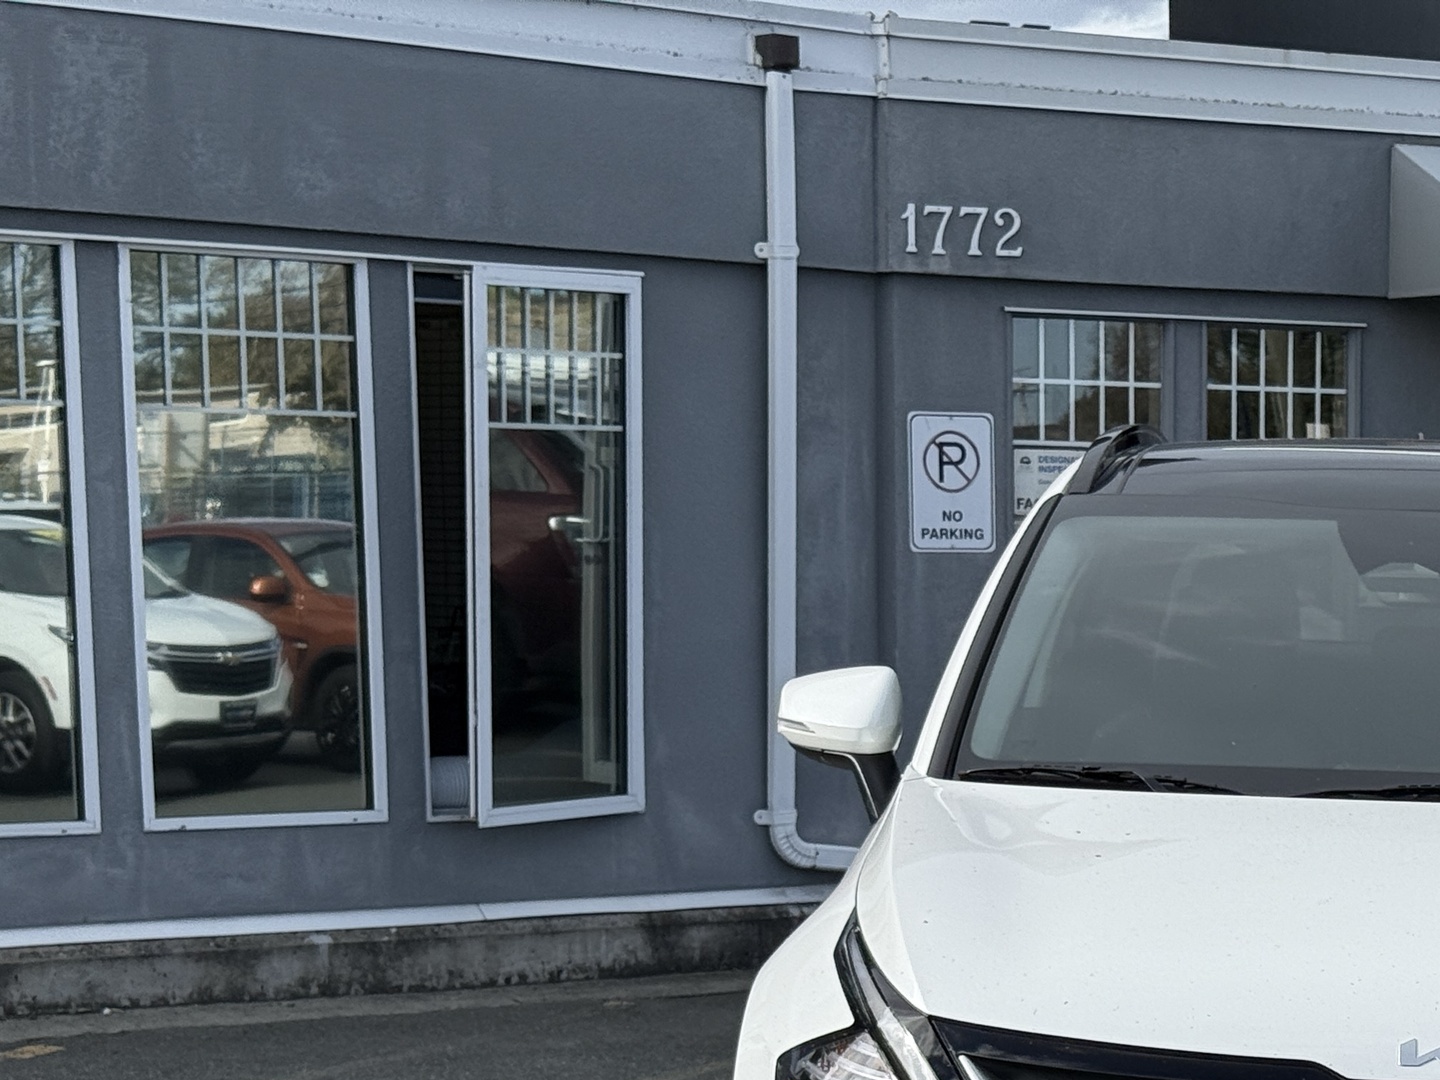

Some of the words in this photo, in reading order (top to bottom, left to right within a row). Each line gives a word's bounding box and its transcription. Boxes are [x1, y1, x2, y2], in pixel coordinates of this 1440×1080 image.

[900, 203, 1024, 257] 1772
[942, 510, 963, 522] NO
[921, 528, 984, 540] PARKING
